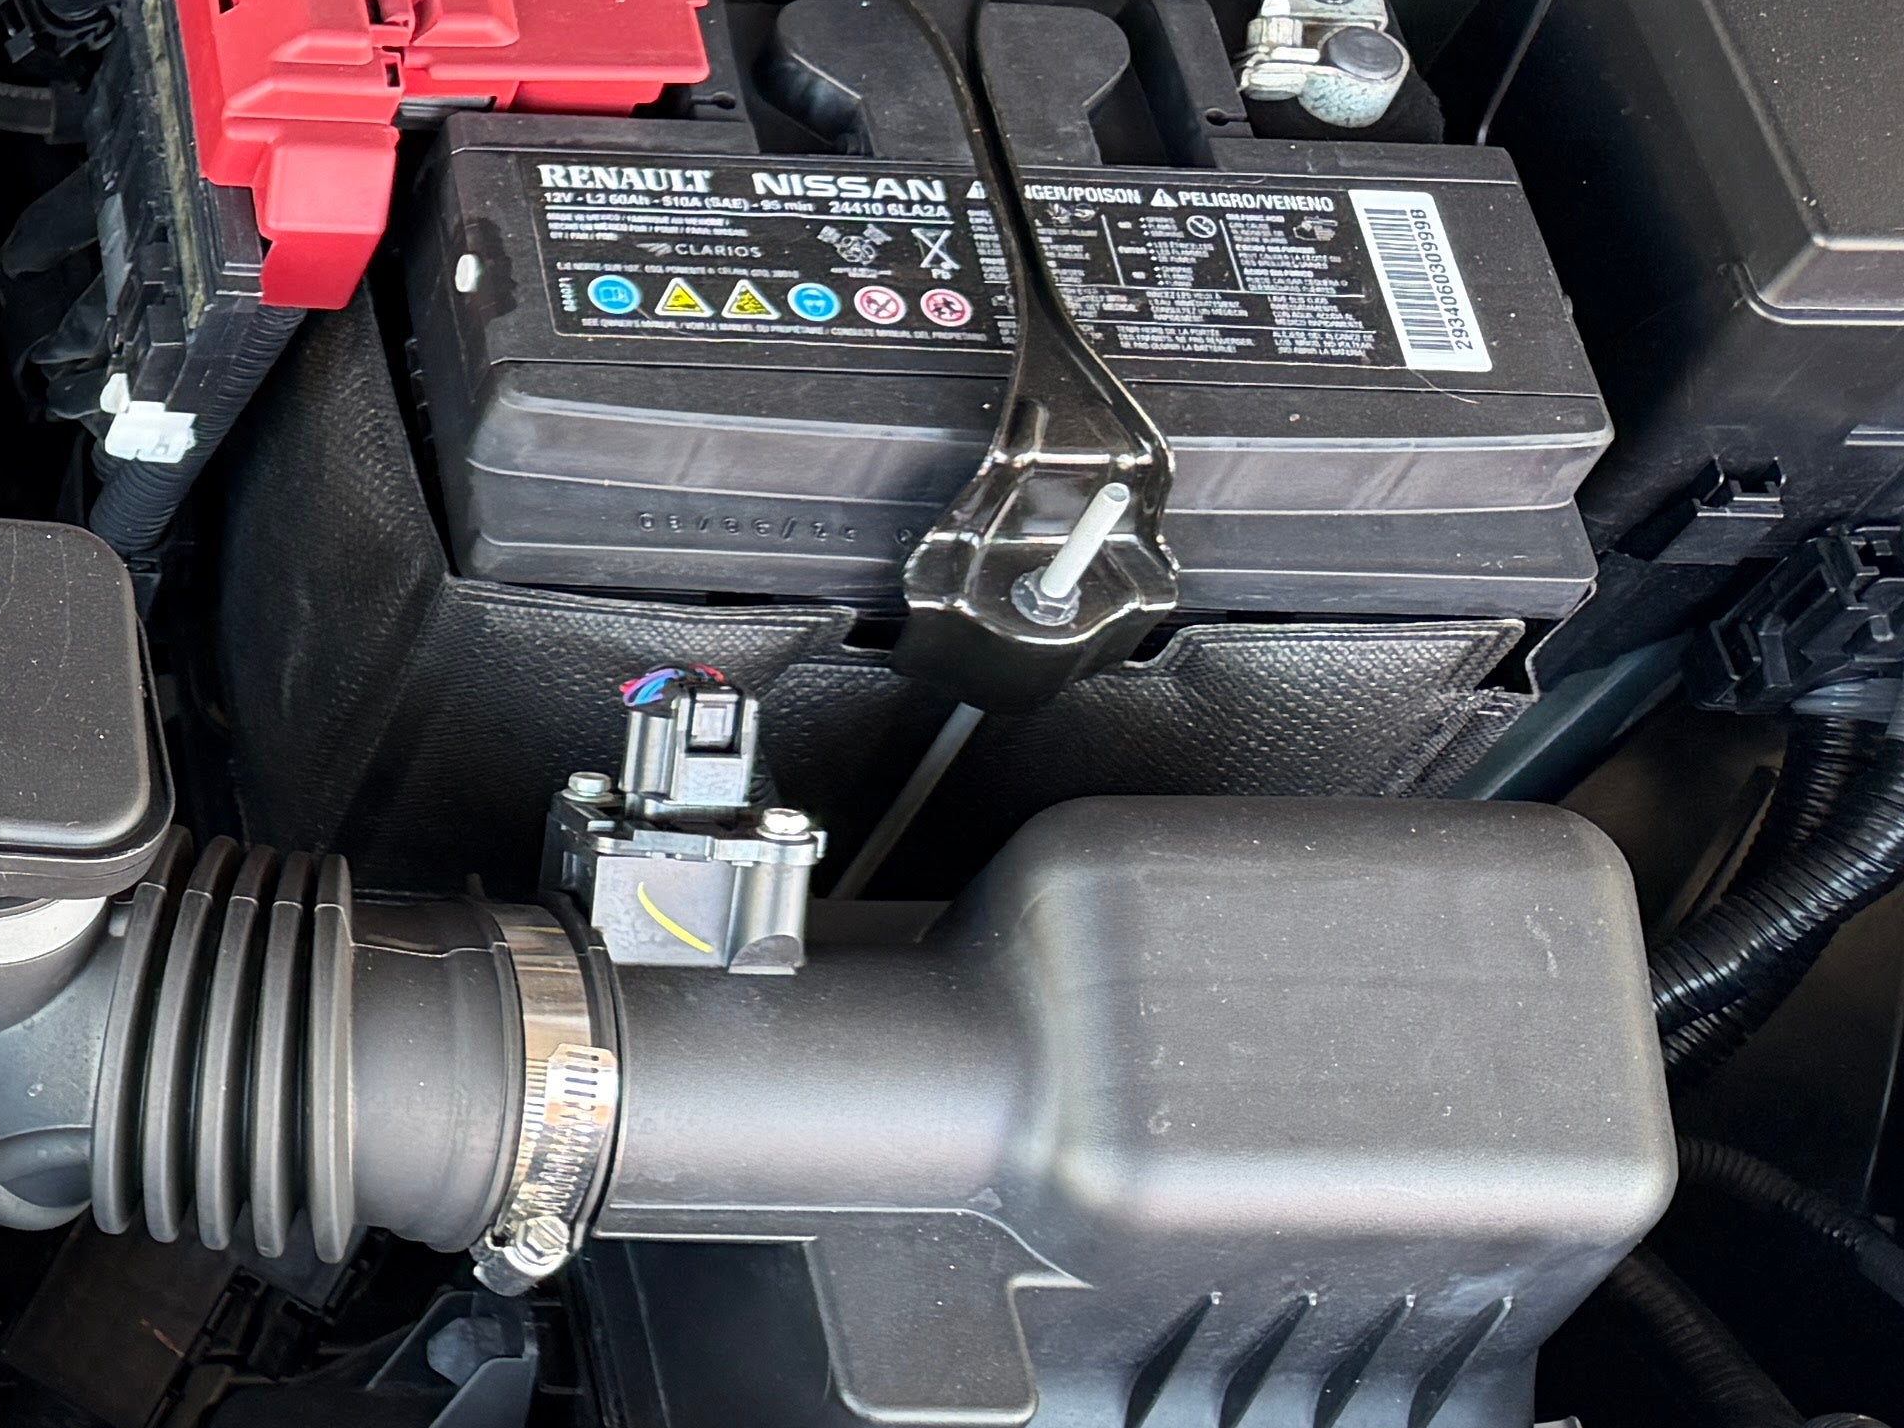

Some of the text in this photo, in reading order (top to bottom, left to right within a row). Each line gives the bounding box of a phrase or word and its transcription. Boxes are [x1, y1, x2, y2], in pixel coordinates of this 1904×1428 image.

[537, 163, 948, 202] RENAULT NISSAN
[1024, 183, 1142, 205] GER/POISON
[544, 192, 574, 204] 12V
[586, 193, 607, 204] L2
[704, 197, 750, 212] (SAE)
[829, 200, 883, 216] 24410
[1177, 189, 1335, 213] PELIGRO/VENENO
[674, 243, 763, 258] CLARIOS
